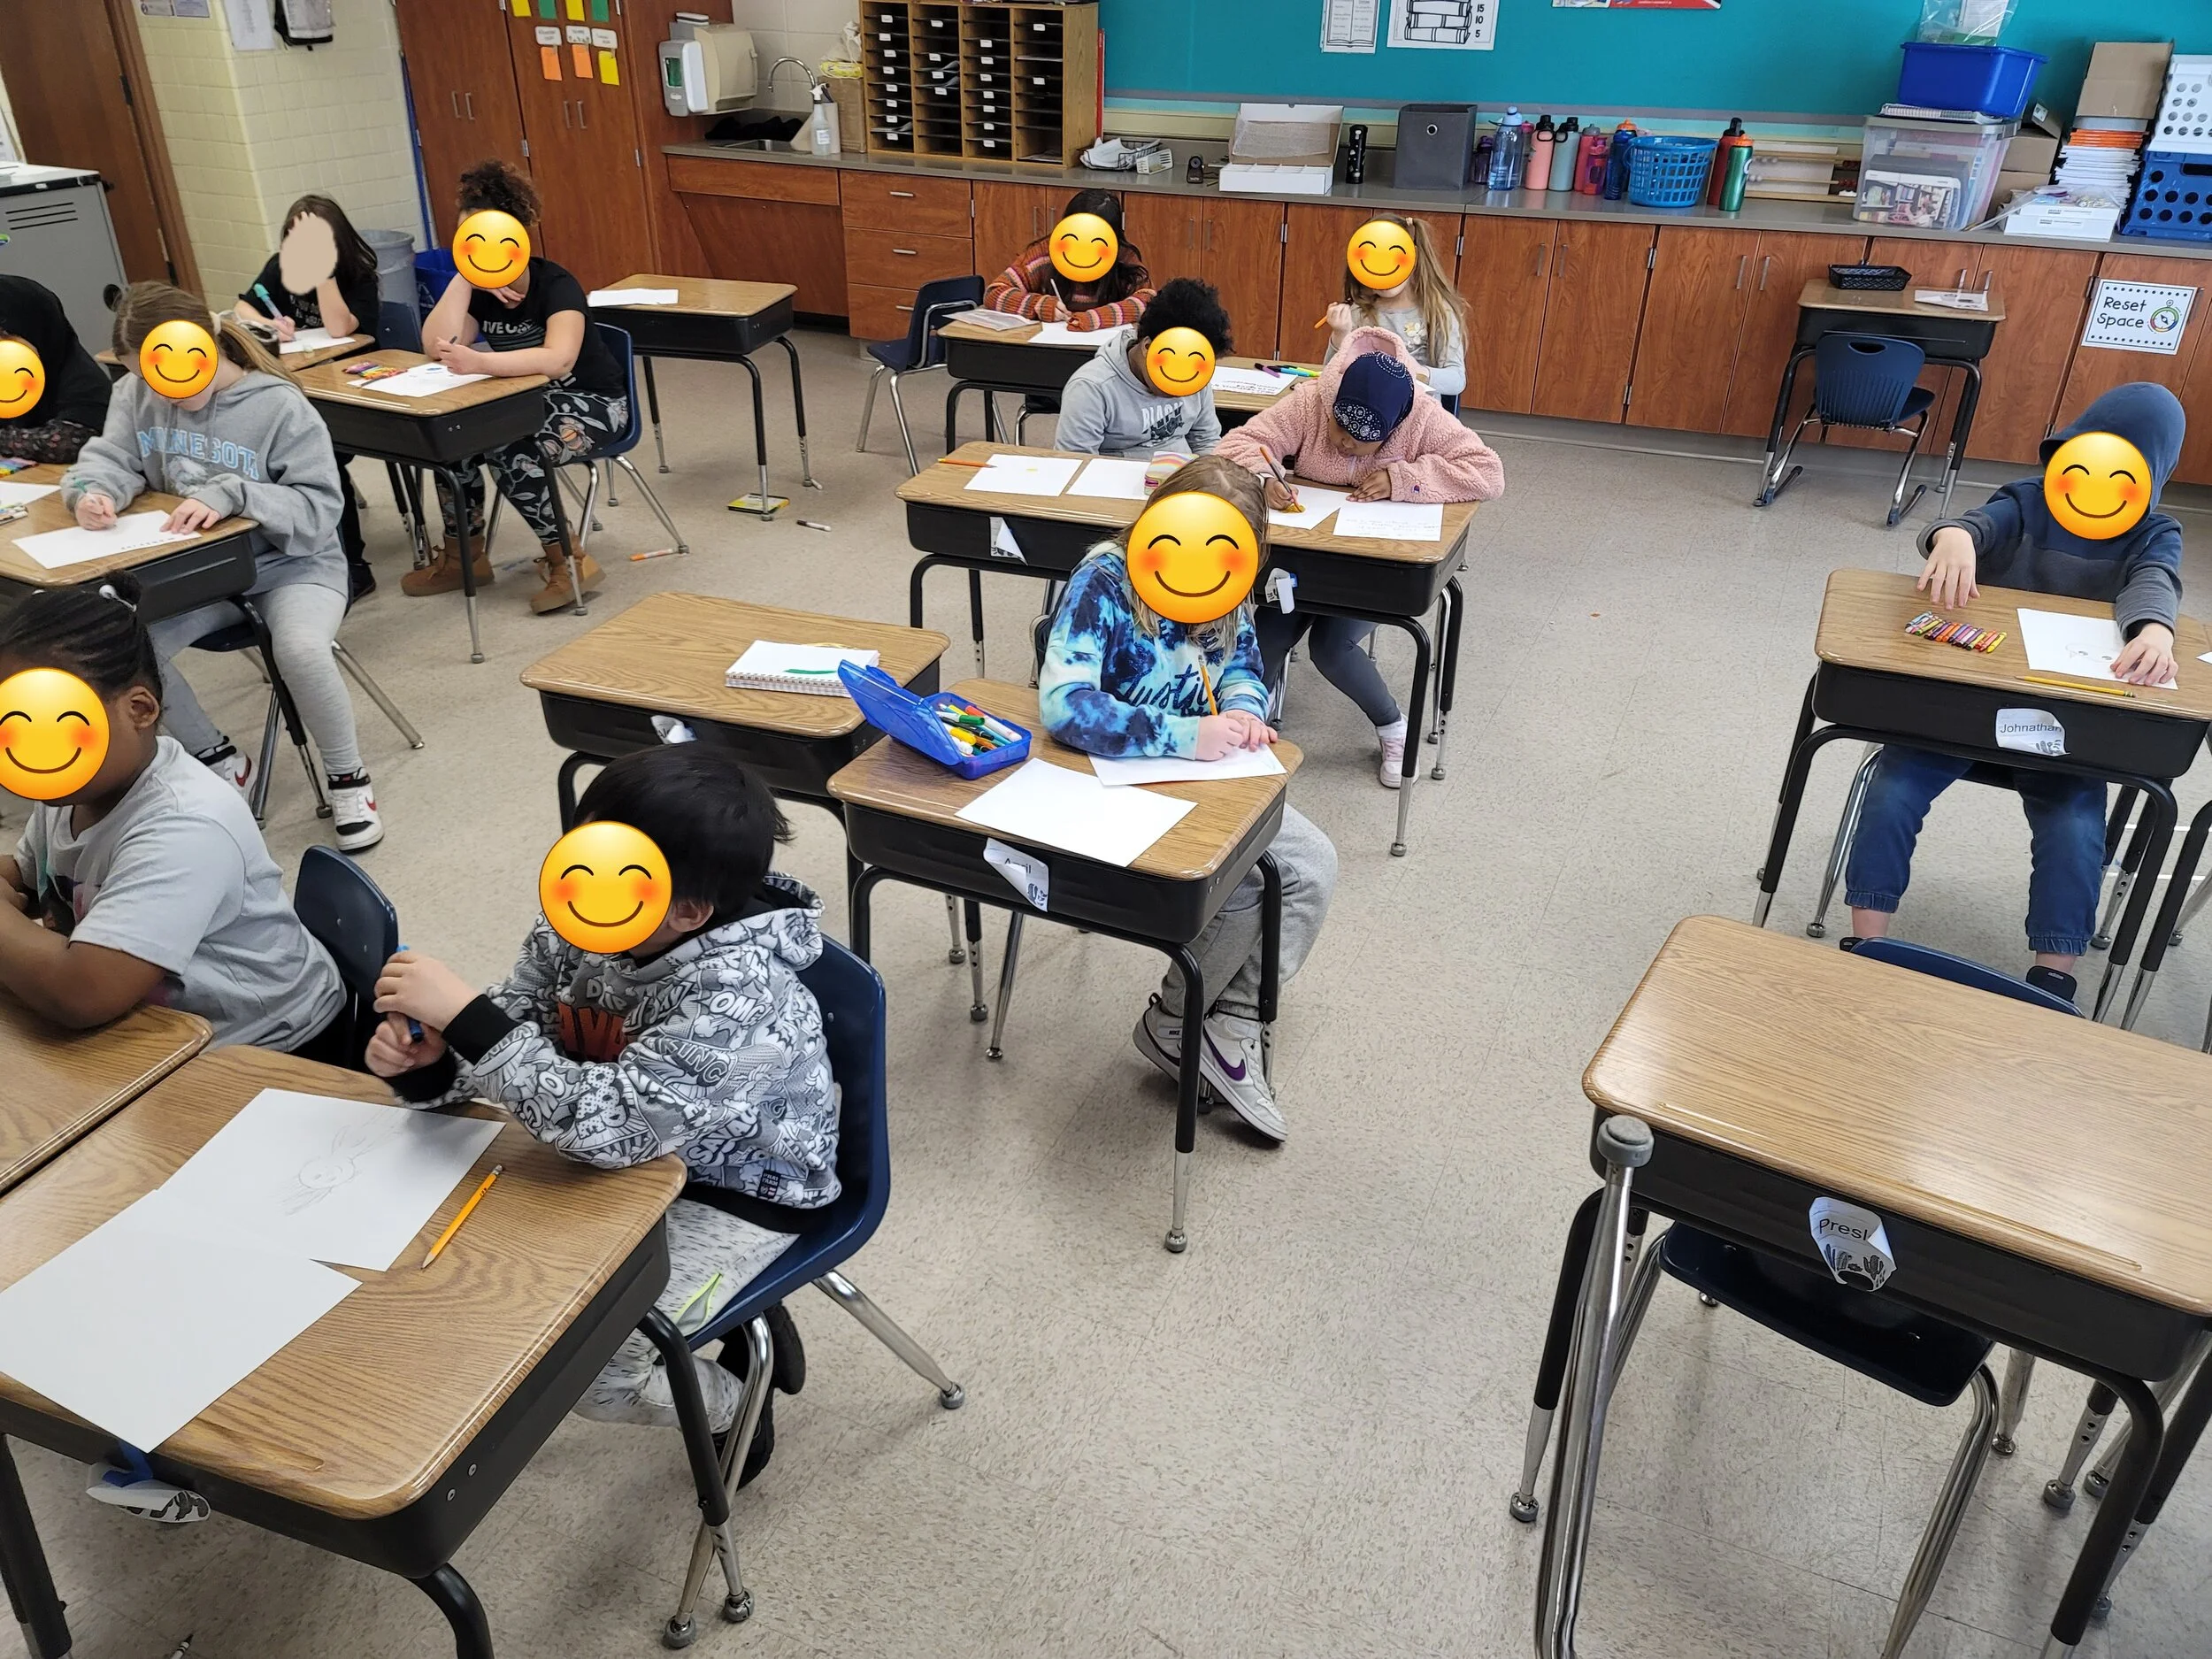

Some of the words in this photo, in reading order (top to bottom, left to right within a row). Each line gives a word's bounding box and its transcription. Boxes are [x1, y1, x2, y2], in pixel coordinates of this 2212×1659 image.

[1477, 4, 1485, 12] 15
[1475, 15, 1483, 24] 10
[1475, 29, 1480, 38] 5
[2103, 296, 2147, 312] Reset
[2097, 312, 2144, 329] Space
[2001, 724, 2062, 733] Johnathan
[1004, 857, 1032, 874] Ail
[1819, 1218, 1870, 1241] Presl
